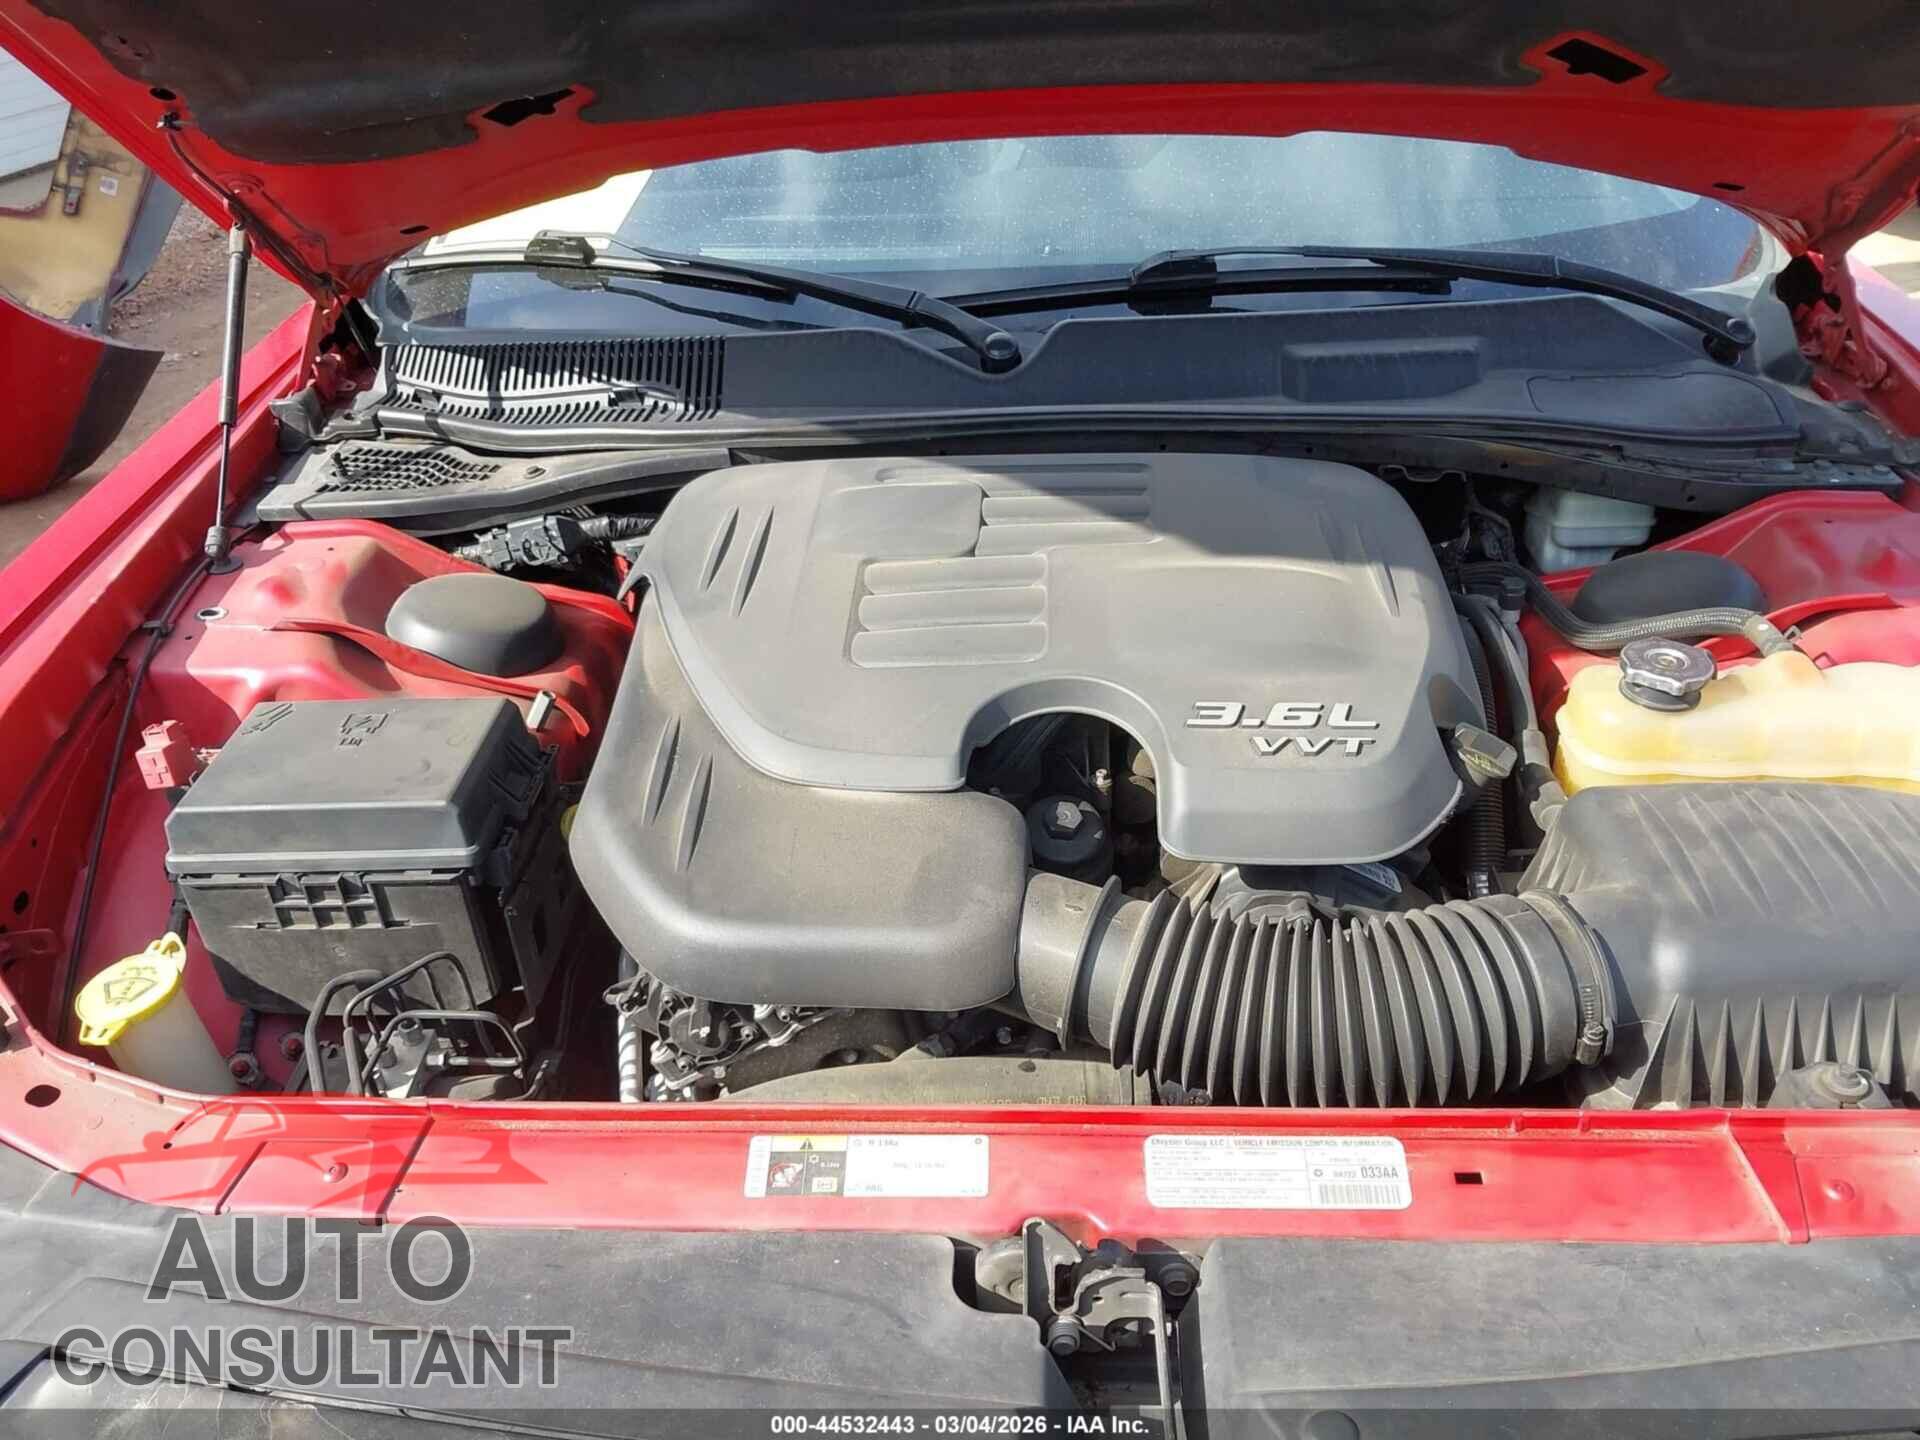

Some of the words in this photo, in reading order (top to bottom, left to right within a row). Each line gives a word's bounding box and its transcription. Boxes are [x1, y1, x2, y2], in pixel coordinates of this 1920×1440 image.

[1185, 701, 1381, 729] 3.6L
[1251, 736, 1376, 756] VVT
[1360, 1166, 1399, 1179] 033AA
